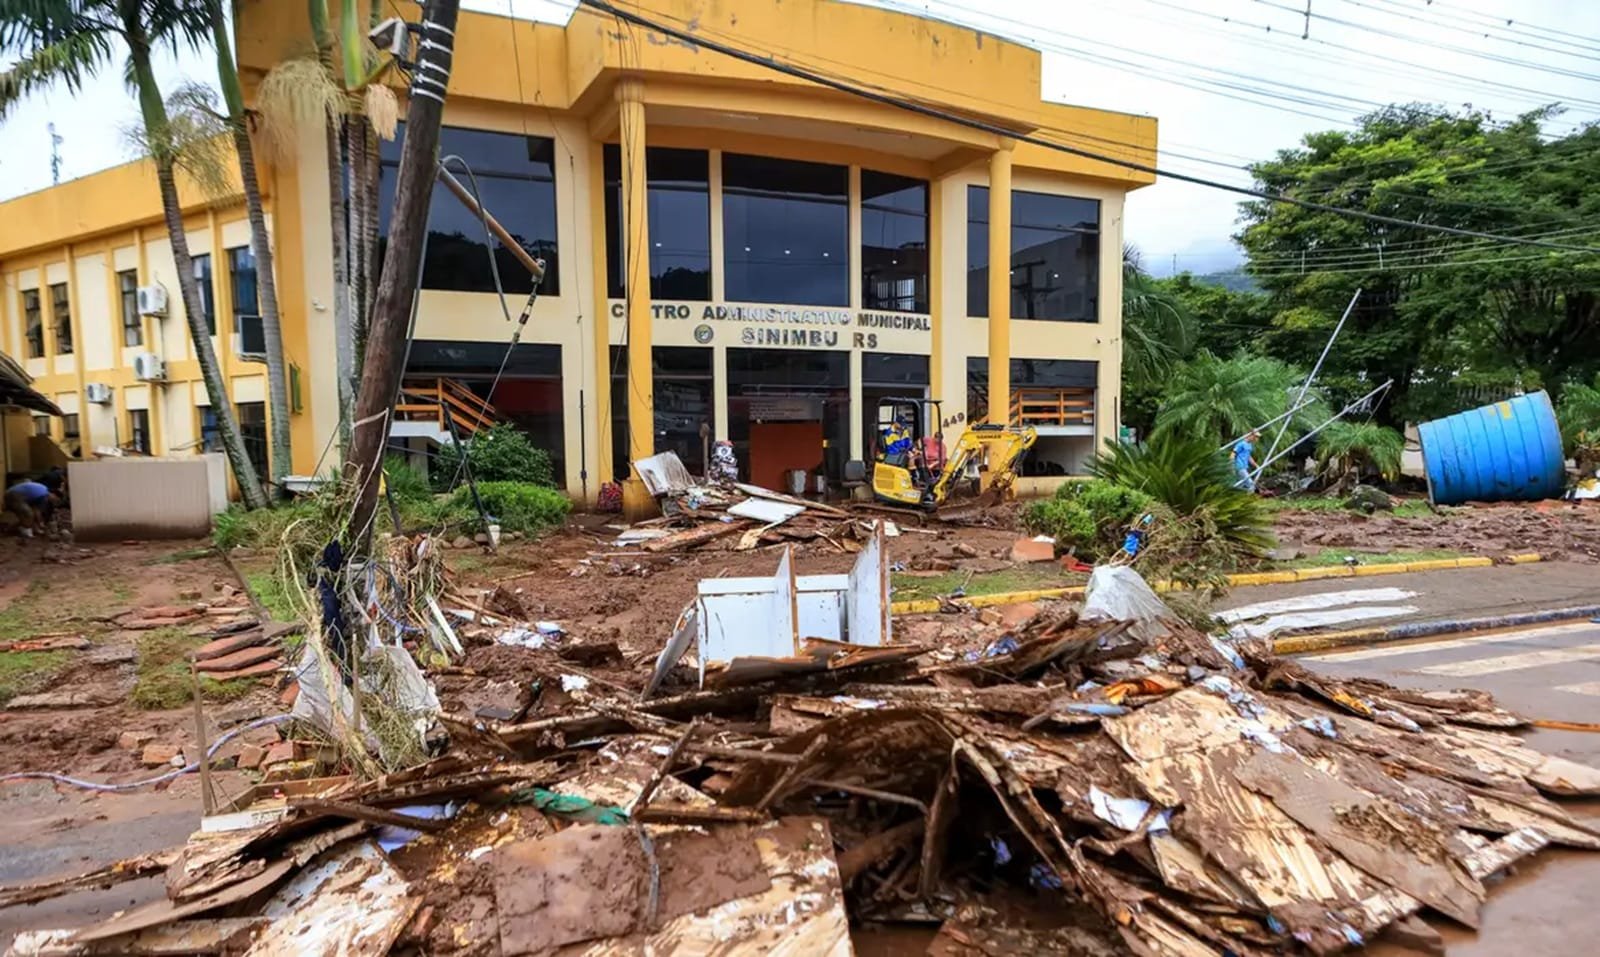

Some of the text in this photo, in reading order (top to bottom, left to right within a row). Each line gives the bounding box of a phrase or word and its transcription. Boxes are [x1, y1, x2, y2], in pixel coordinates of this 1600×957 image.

[611, 303, 931, 331] CTRO ADMINISTRATIVO MUNICIPAL
[741, 327, 878, 348] SINIMBU RS
[943, 412, 965, 428] 449
